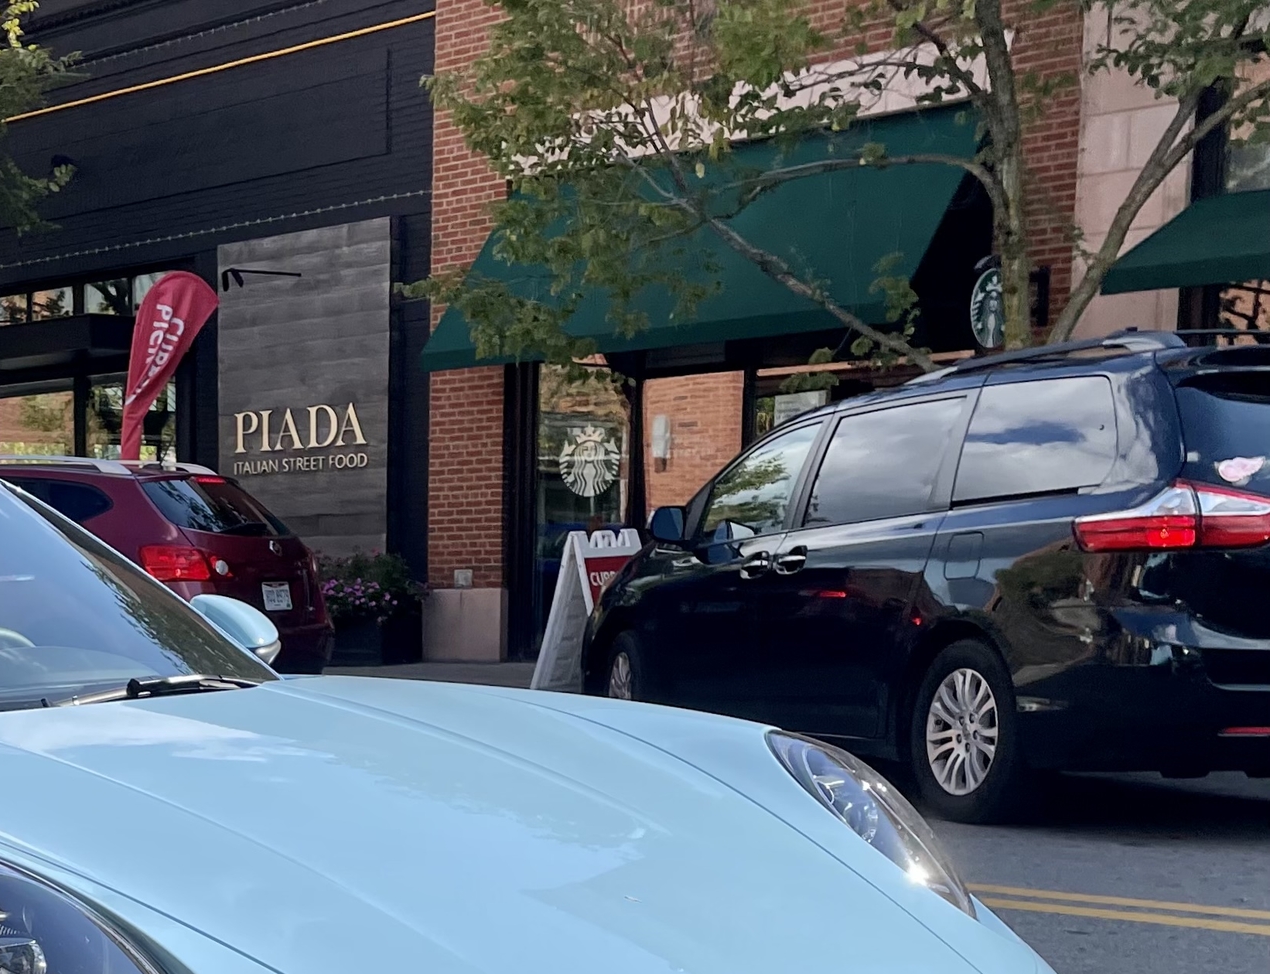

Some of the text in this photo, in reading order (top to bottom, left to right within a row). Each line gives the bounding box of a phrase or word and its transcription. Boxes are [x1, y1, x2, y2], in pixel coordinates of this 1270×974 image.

[234, 402, 368, 454] PIADA
[233, 452, 368, 475] ITALIAN STREET FOOD
